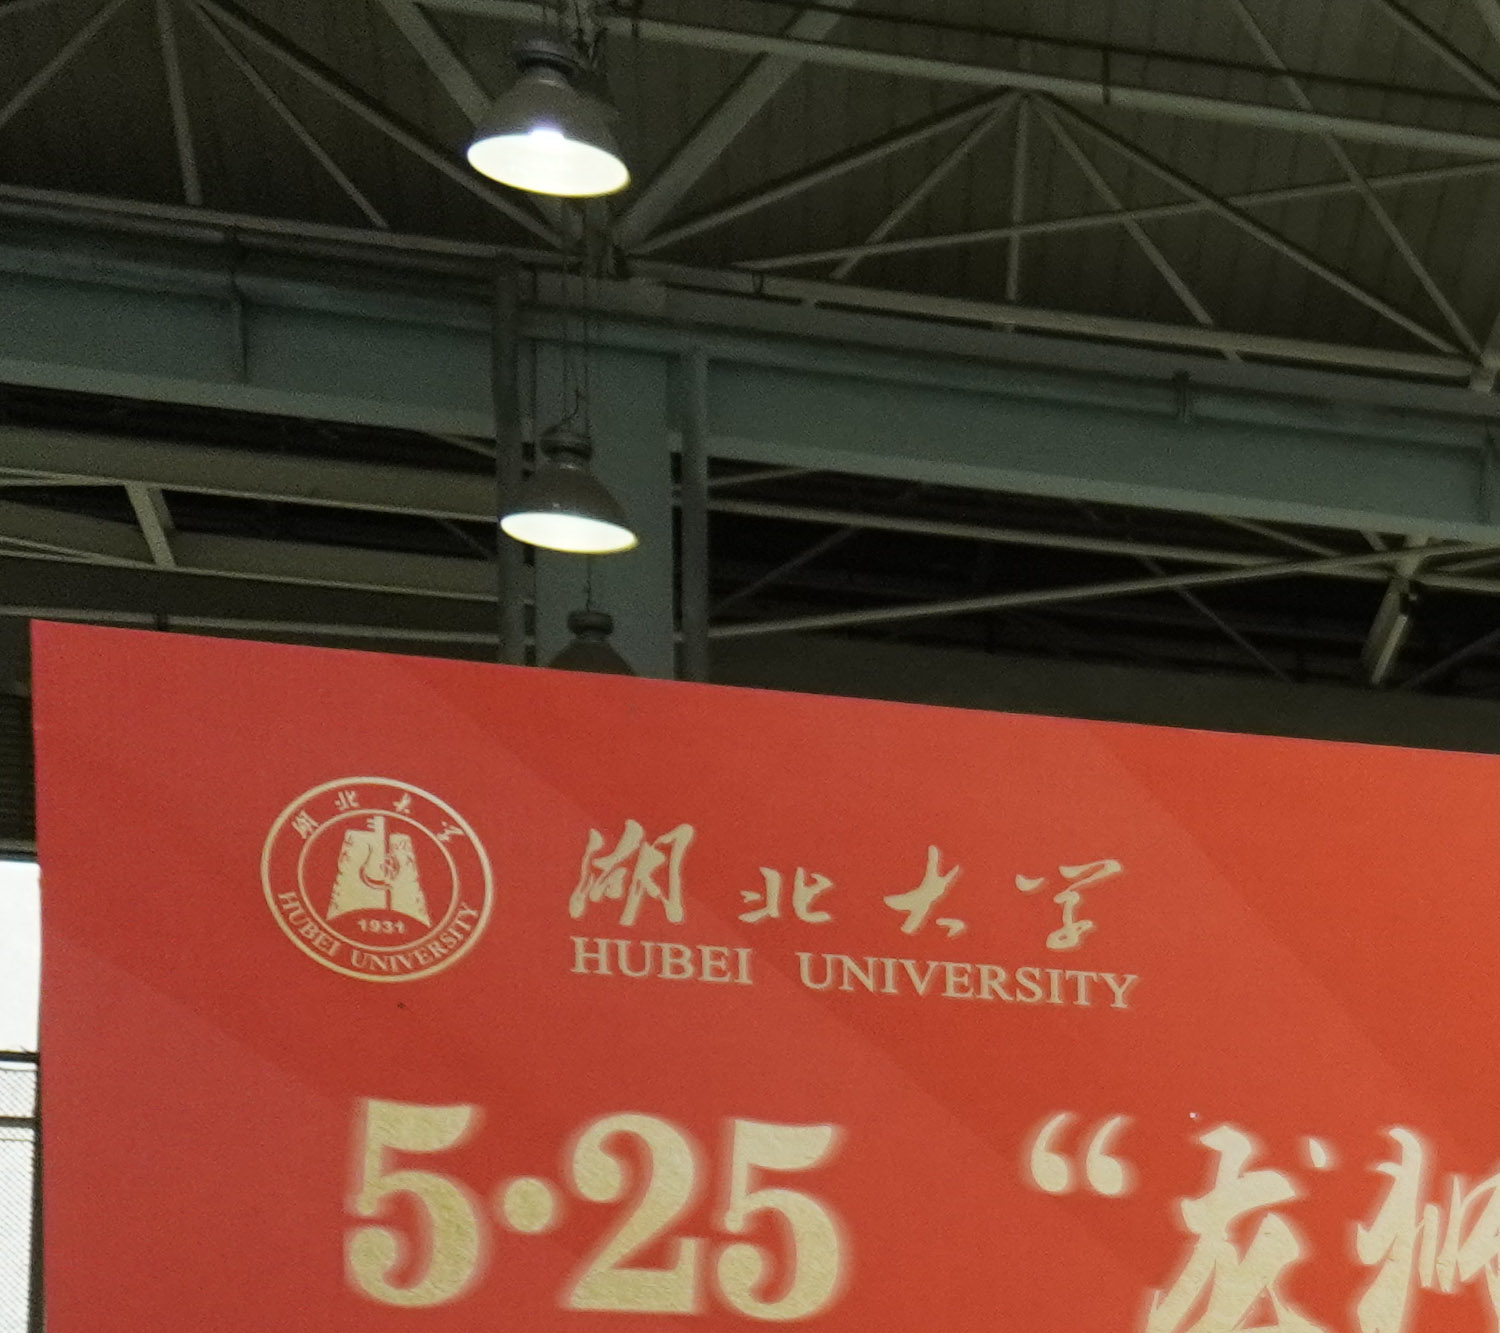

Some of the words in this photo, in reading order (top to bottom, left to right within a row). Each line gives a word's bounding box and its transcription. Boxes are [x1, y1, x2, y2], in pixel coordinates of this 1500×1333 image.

[569, 818, 1123, 950] 湖北大学
[277, 890, 342, 957] HUBEI
[350, 902, 479, 973] UNIVERSITY
[570, 935, 753, 985] HUBEI
[795, 951, 1139, 1009] UNIVERSITY
